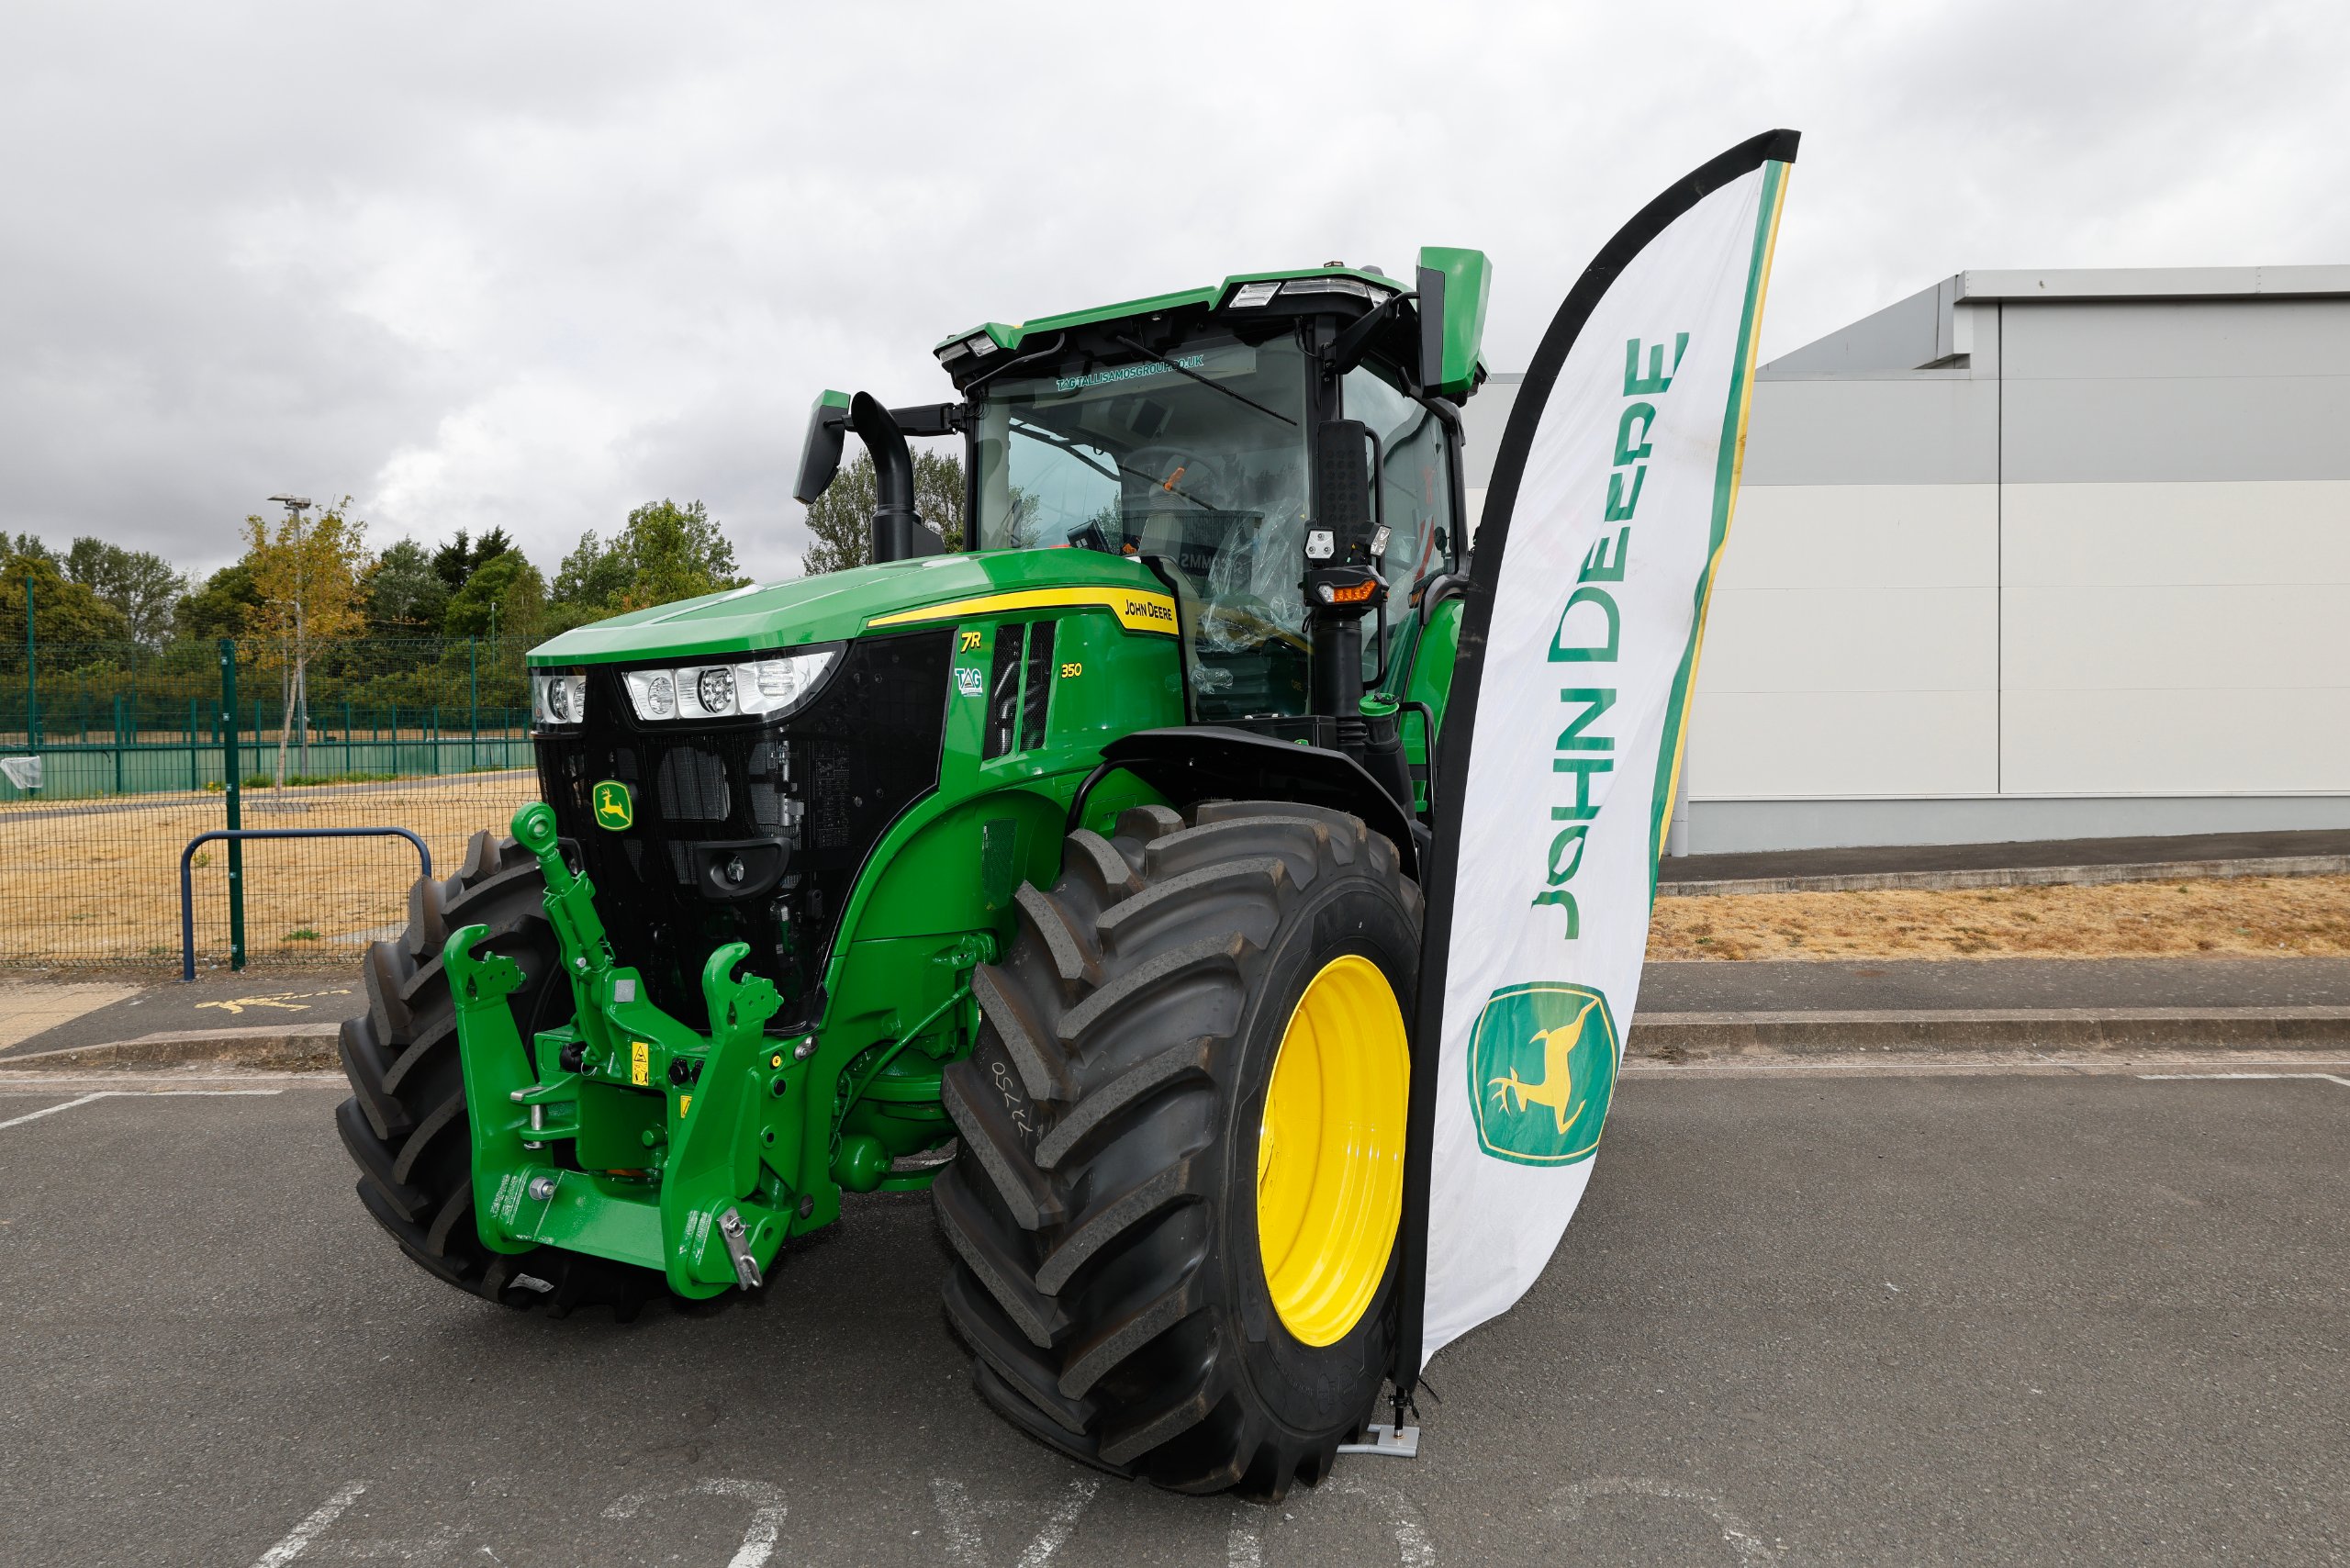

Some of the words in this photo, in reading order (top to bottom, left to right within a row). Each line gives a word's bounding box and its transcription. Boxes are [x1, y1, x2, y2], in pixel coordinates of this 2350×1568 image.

[1057, 377, 1076, 391] TAG
[1547, 331, 1690, 663] DEERE
[1125, 599, 1147, 617] JOHN
[1147, 602, 1173, 622] DEERE
[960, 632, 981, 654] 7R
[955, 668, 981, 689] TAG
[1061, 663, 1082, 678] 350
[1531, 688, 1617, 941] JOHN
